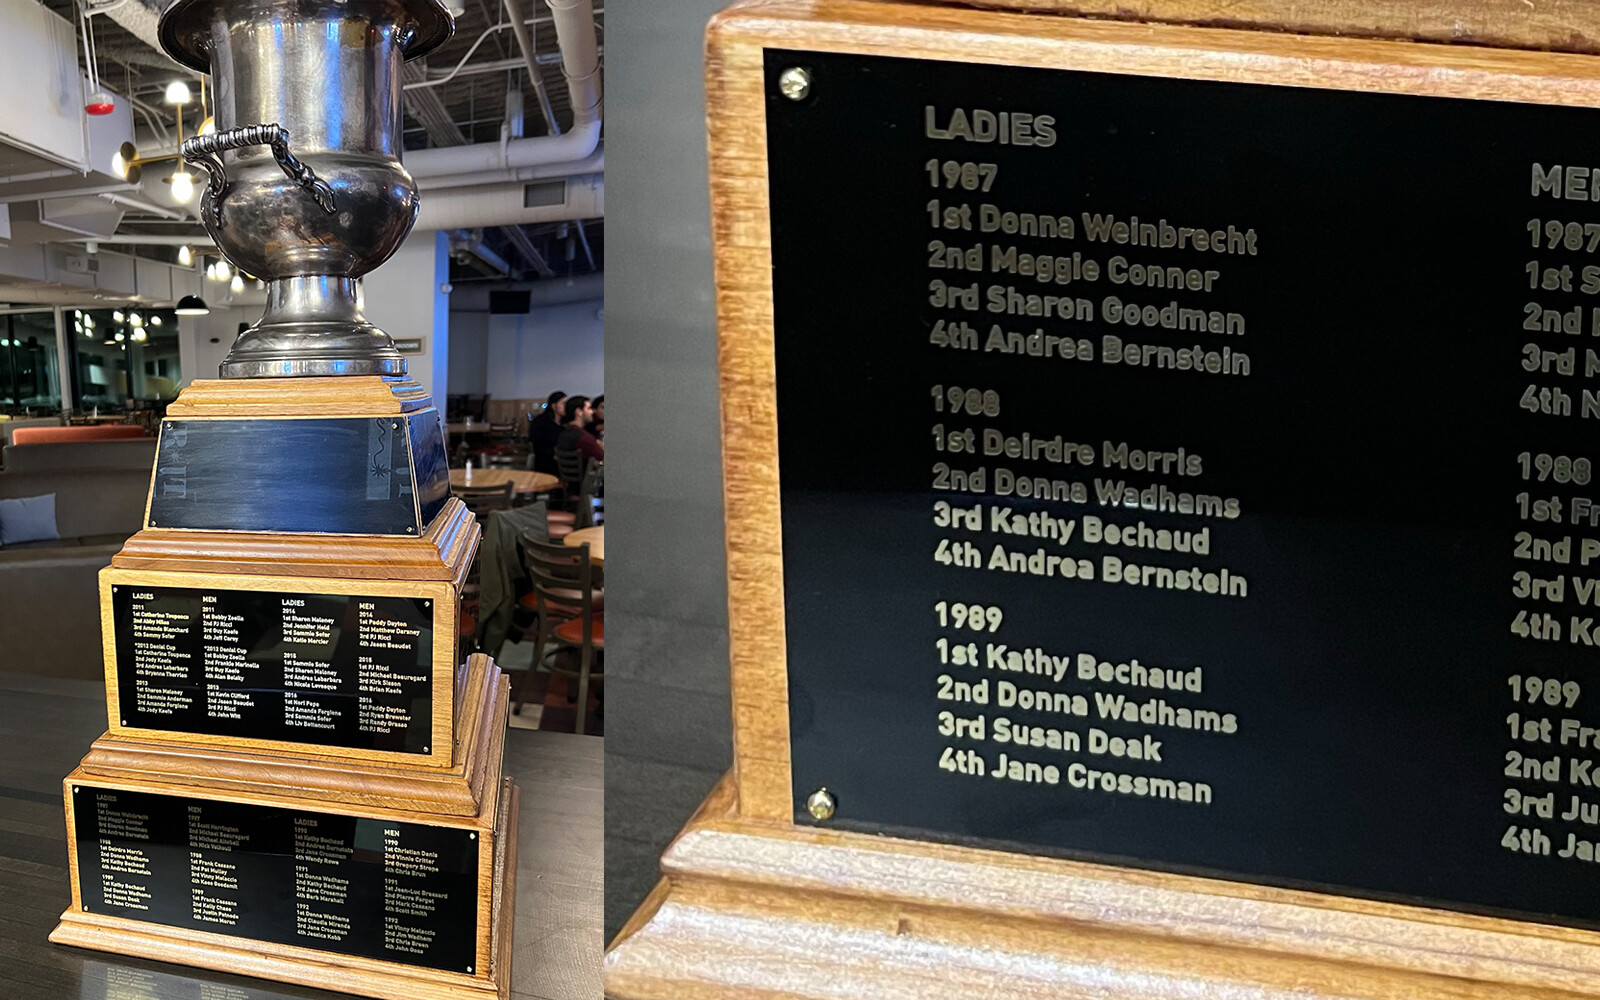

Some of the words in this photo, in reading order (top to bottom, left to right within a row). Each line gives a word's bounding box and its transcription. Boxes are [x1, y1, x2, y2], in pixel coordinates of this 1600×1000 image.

[925, 106, 1056, 147] LADIES
[925, 159, 998, 192] 1987
[926, 199, 972, 231] 1st
[980, 204, 1074, 239] Donna
[1082, 212, 1258, 255] Weinbrecht
[1526, 218, 1600, 253] 1987
[928, 240, 983, 271] 2nd
[991, 246, 1099, 285] Maggie
[1108, 256, 1219, 292] Conner
[1525, 260, 1573, 292] 1st
[928, 279, 979, 311] 3rd
[986, 285, 1093, 321] Sharon
[1102, 296, 1245, 335] Goodman
[1523, 302, 1582, 334] 2nd
[929, 319, 978, 350] 4th
[985, 324, 1093, 361] Andrea
[1102, 335, 1250, 376] Bernstein
[1522, 343, 1575, 376] 3rd
[931, 384, 1000, 417] 1988
[1519, 384, 1571, 416] 4th
[932, 423, 975, 453] 1st
[983, 428, 1095, 465] Deirdre
[1102, 440, 1202, 476] Morris
[1517, 452, 1591, 485] 1988
[932, 462, 986, 493] 2nd
[994, 468, 1087, 503] Donna
[1094, 478, 1241, 519] Wadhams
[1516, 492, 1562, 523] 1st
[933, 501, 982, 532] 3rd
[991, 506, 1075, 545] Kathy
[1083, 515, 1210, 555] Bechaud
[1514, 531, 1571, 564] 2nd
[934, 539, 981, 569] 4th
[988, 544, 1094, 580] Andrea
[1102, 556, 1248, 597] Bernstein
[1512, 571, 1565, 602] 3rd
[935, 601, 1003, 632] 1989
[1510, 610, 1561, 640] 4th
[936, 638, 978, 667] 1st
[986, 643, 1069, 682] Kathy
[1077, 653, 1202, 693] Bechaud
[937, 675, 989, 704] 2nd
[998, 681, 1088, 717] Donna
[1095, 692, 1238, 734] Wadhams
[1508, 674, 1580, 708] 1989
[938, 711, 985, 741] 3rd
[992, 718, 1081, 752] Susan
[1088, 728, 1162, 762] Deak
[1506, 712, 1552, 743] 1st
[938, 747, 985, 777] 4th
[991, 753, 1060, 785] Jane
[1068, 763, 1212, 804] Crossman
[1504, 750, 1560, 782] 2nd
[1503, 788, 1554, 819] 3rd
[294, 818, 318, 826] LADIES
[394, 847, 420, 856] Christian
[1501, 825, 1550, 855] 4th
[394, 886, 420, 895] Jean-Luc
